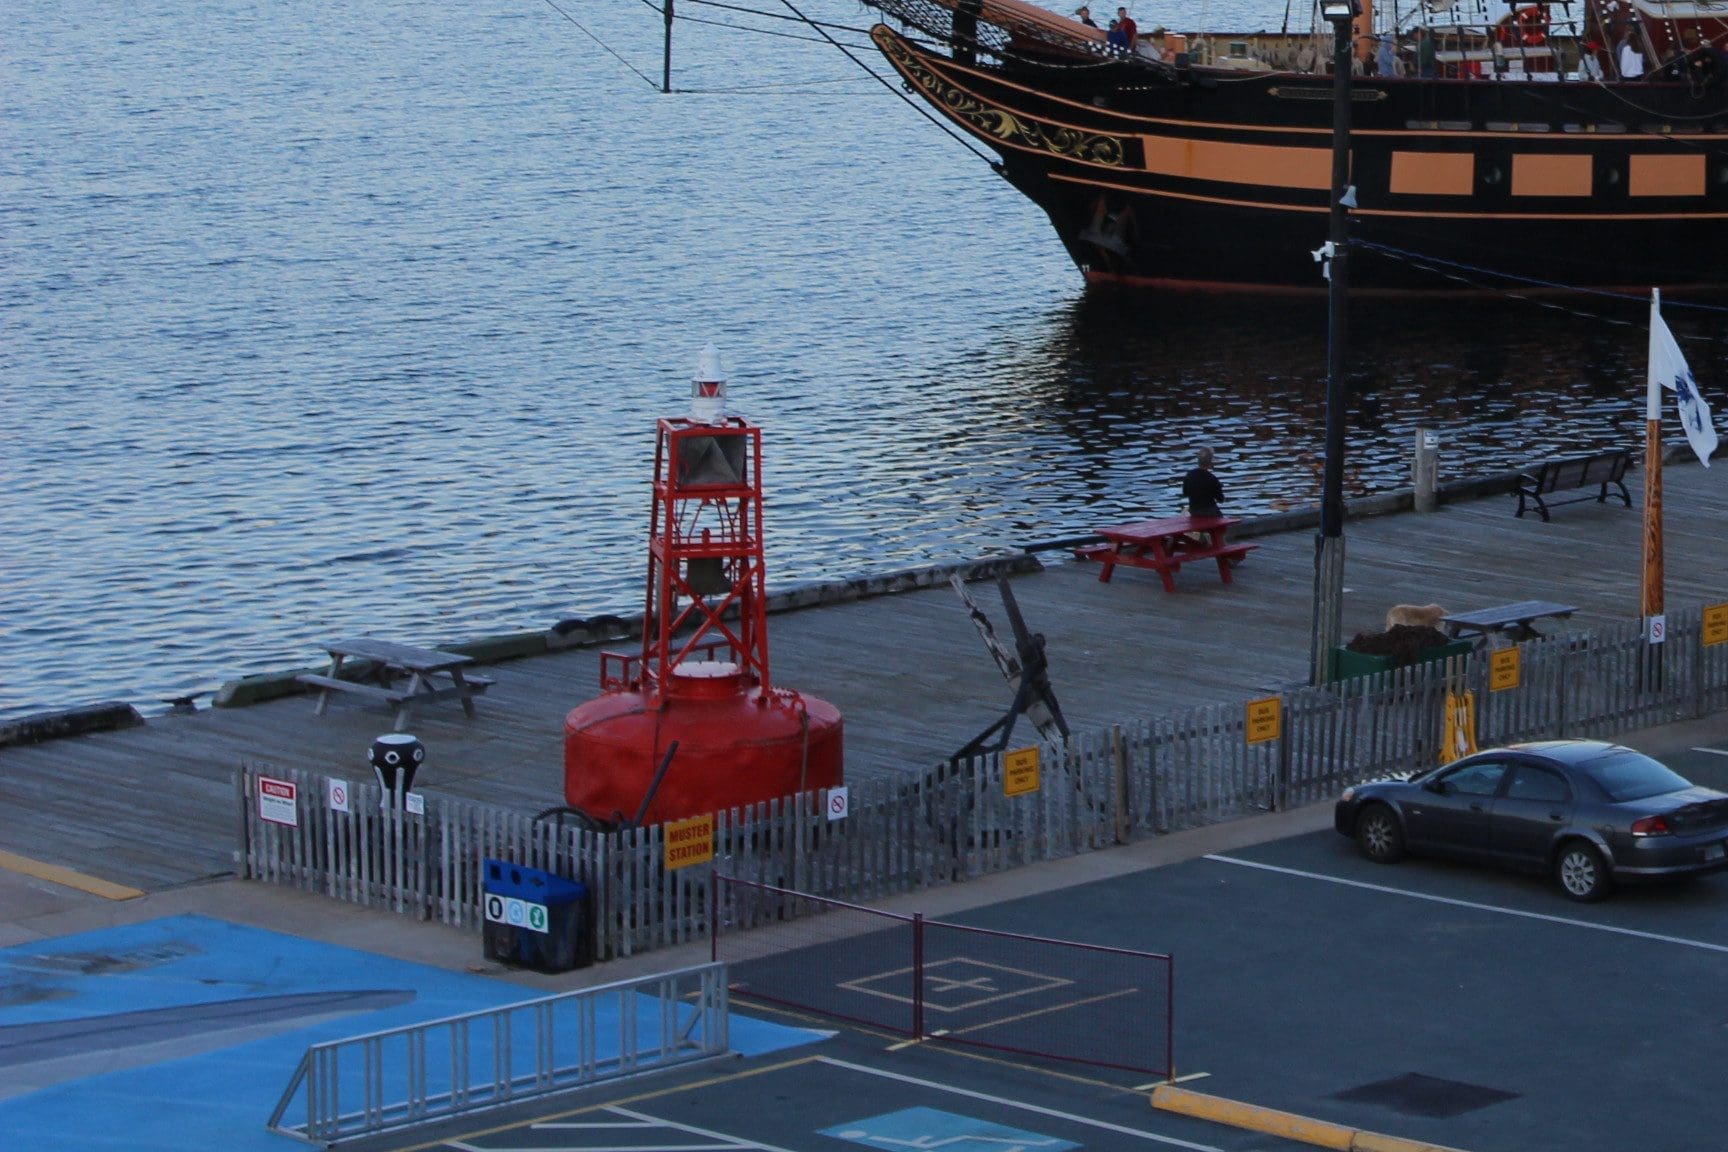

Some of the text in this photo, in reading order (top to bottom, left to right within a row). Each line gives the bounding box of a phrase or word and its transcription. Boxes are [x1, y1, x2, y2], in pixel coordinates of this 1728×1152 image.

[1014, 758, 1027, 767] BUS
[1009, 765, 1034, 776] PARKING
[1014, 776, 1029, 785] ONLY
[669, 823, 710, 843] MUSTER
[669, 842, 709, 862] STATION
